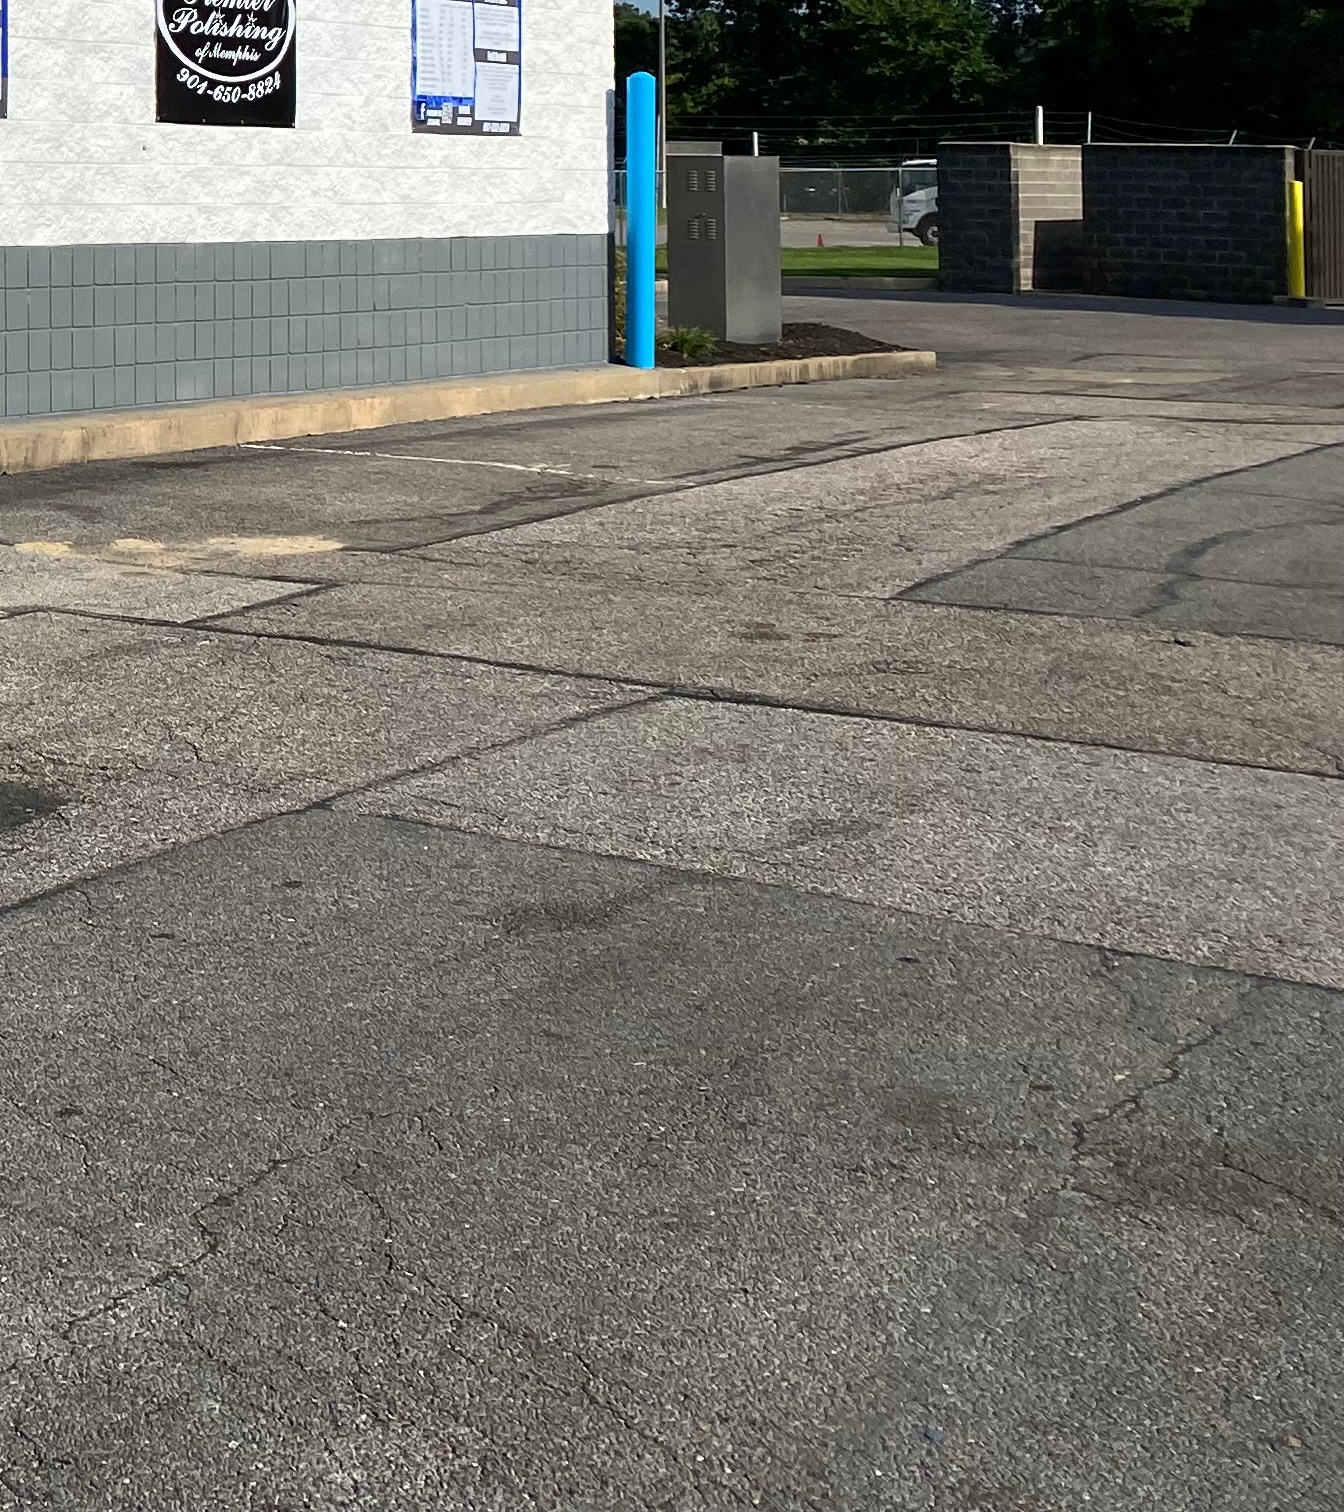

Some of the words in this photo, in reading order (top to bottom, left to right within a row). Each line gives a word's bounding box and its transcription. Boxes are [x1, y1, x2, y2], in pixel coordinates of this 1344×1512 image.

[169, 7, 287, 50] Polishing
[195, 41, 210, 64] of
[209, 41, 261, 66] Memphis
[176, 67, 281, 104] 901-650-8824
